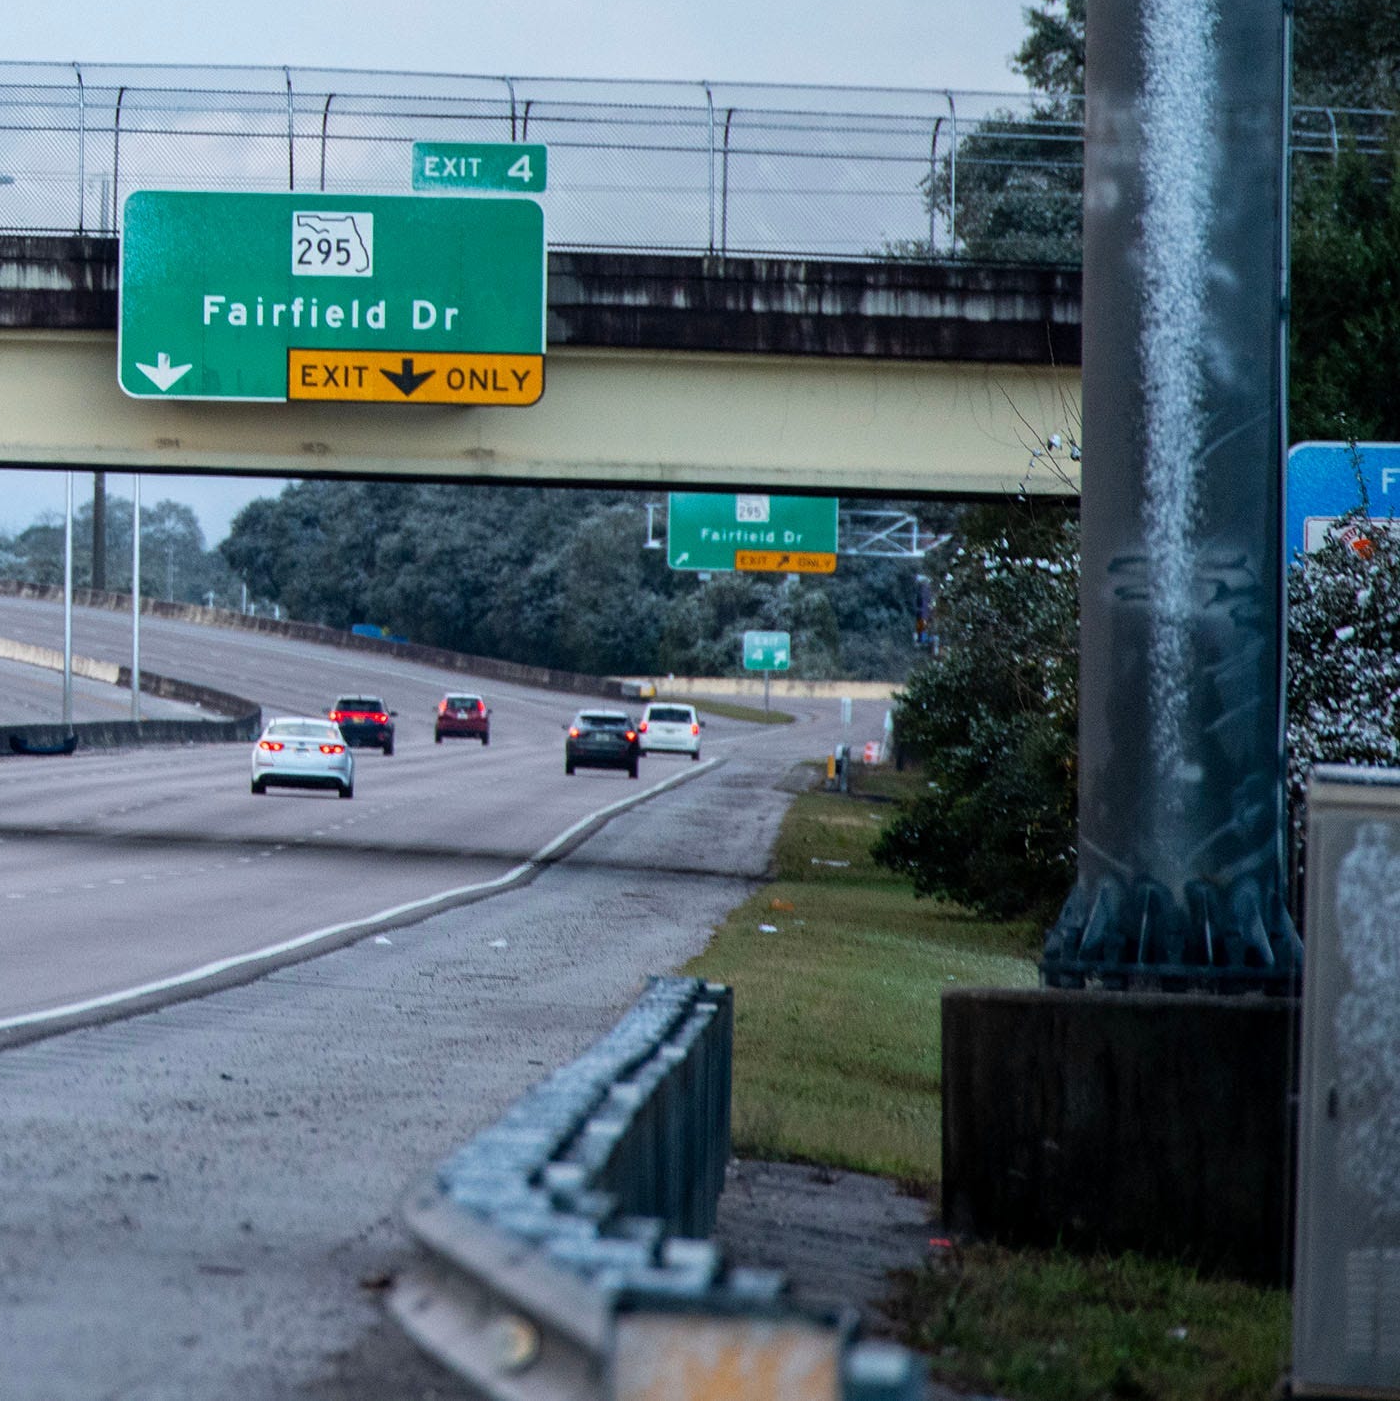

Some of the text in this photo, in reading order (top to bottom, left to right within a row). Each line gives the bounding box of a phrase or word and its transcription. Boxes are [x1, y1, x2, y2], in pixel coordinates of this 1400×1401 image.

[424, 154, 534, 183] EXIT 4
[296, 237, 352, 267] 295
[203, 295, 459, 331] Fairfield Dr
[301, 364, 531, 392] EXIT ONLY
[739, 505, 761, 518] 295
[701, 528, 803, 544] Fairfield Dr
[740, 556, 832, 567] EXIT ONLY
